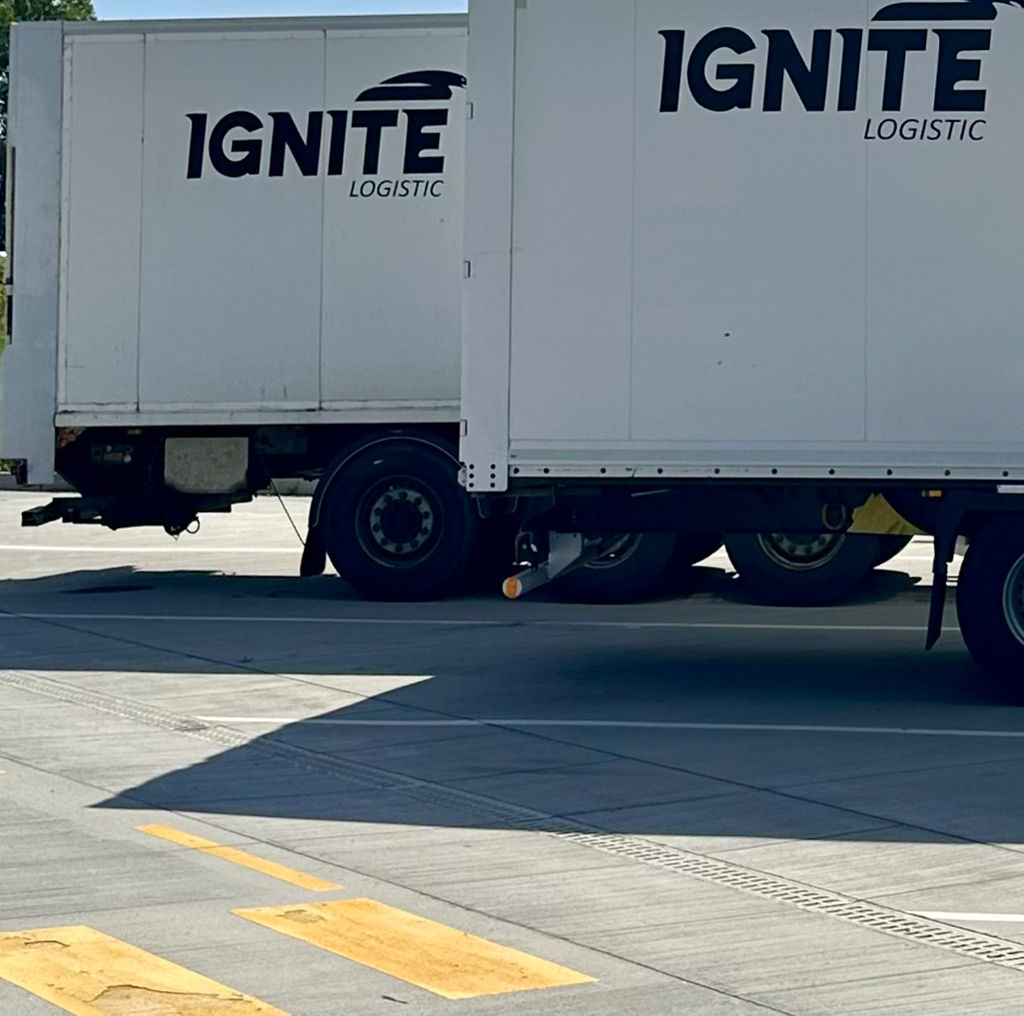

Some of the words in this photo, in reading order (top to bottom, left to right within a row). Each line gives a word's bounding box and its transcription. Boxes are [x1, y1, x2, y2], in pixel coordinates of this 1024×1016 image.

[658, 27, 993, 113] IGNITE
[185, 109, 449, 179] IGNITE
[864, 118, 987, 141] LOGISTIC
[349, 179, 445, 199] LOGISTIC
